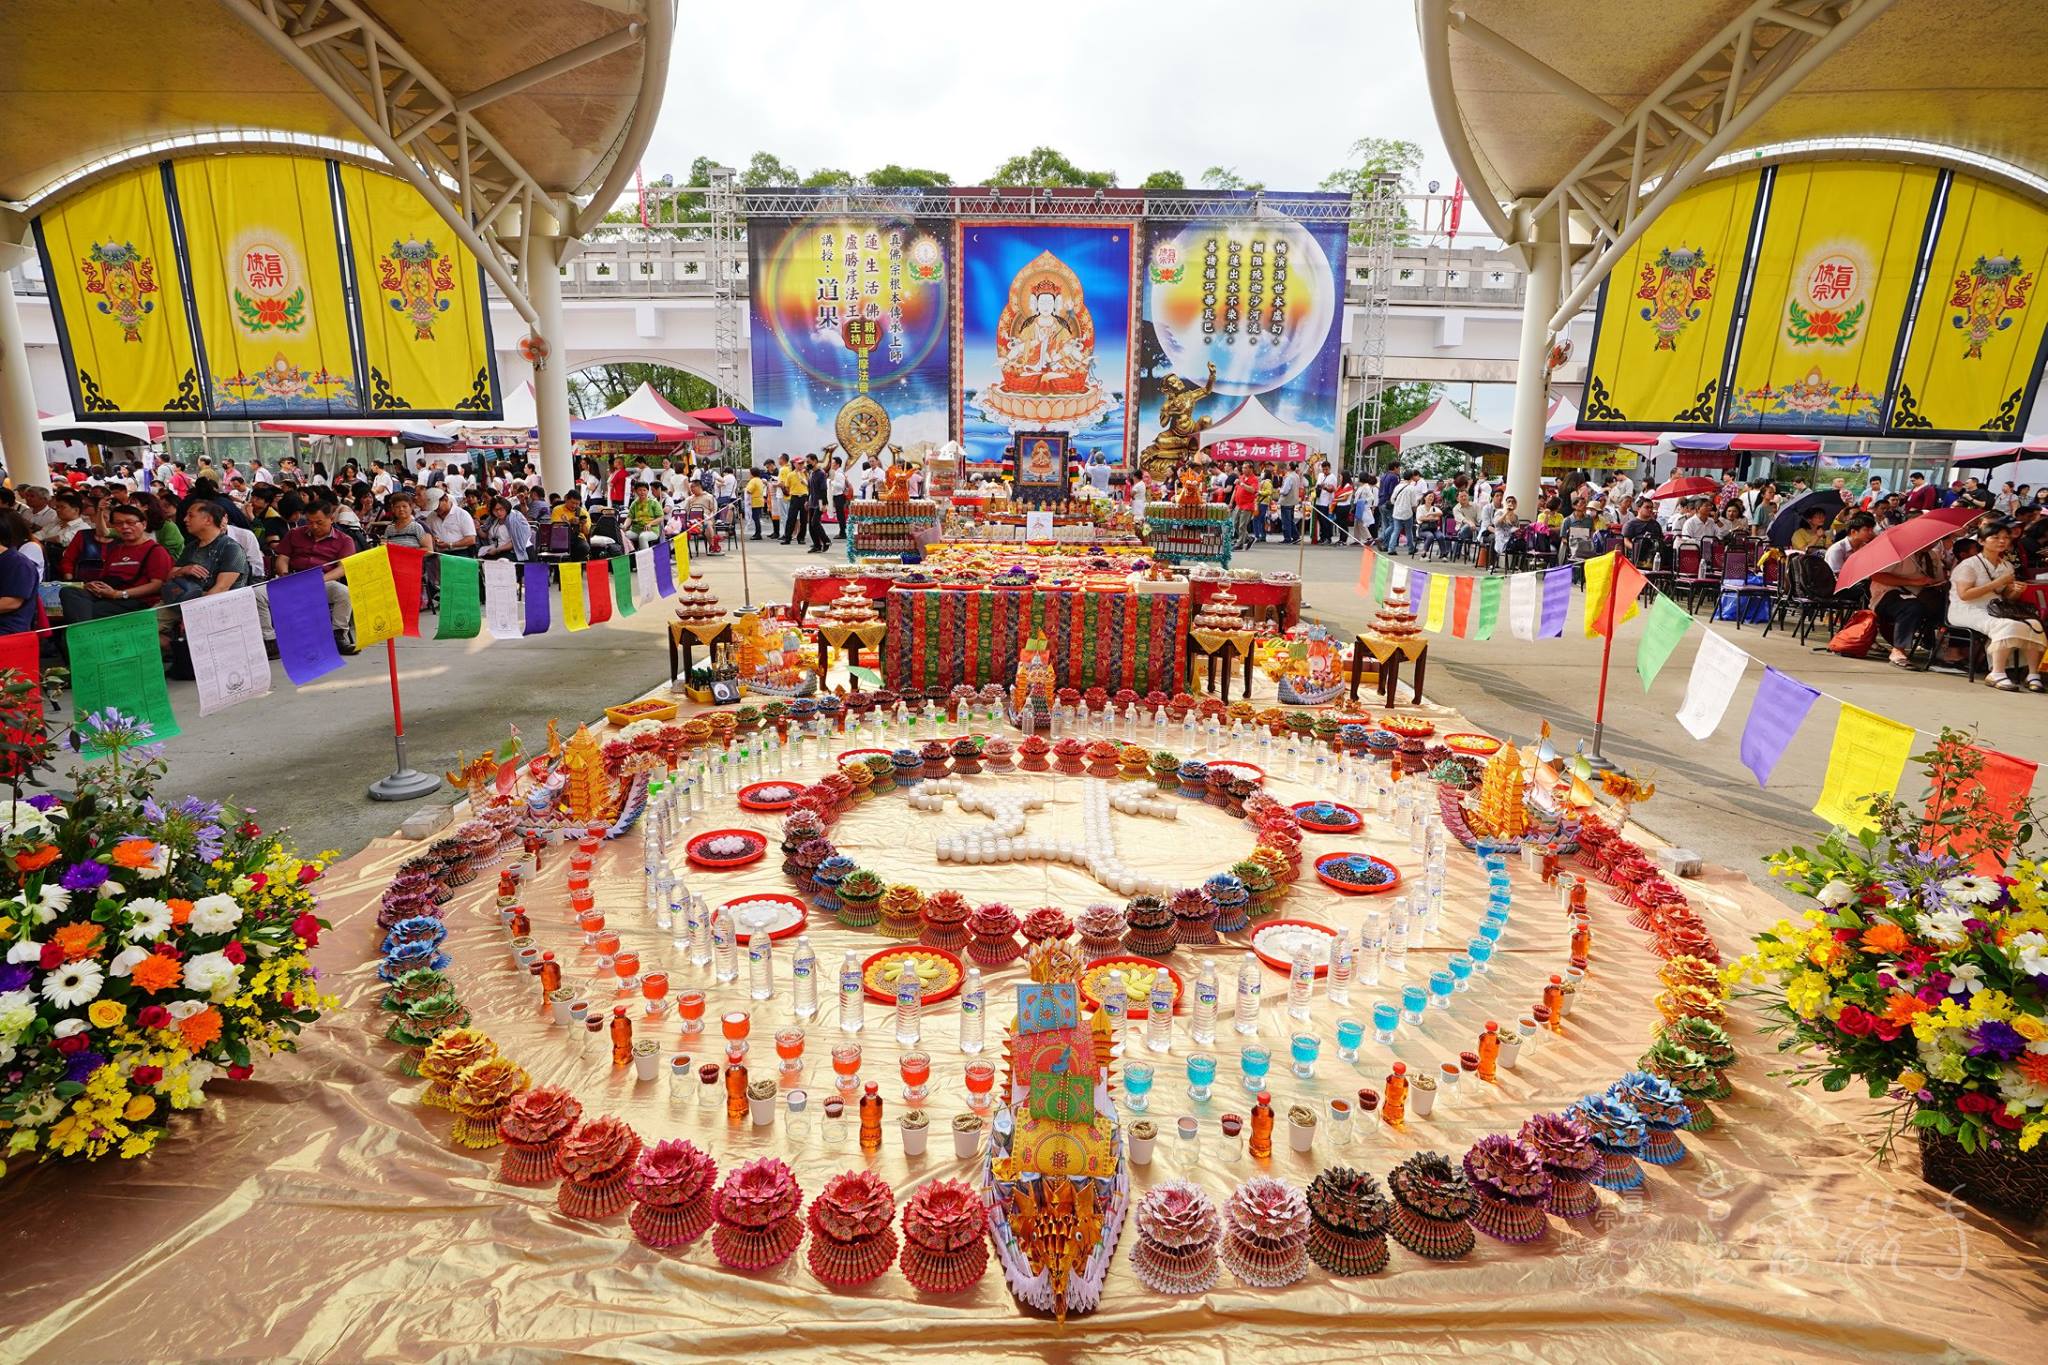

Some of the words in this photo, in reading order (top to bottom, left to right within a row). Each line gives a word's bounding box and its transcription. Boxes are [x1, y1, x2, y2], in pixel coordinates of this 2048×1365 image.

[864, 233, 880, 318] 蓮生活佛
[850, 321, 862, 345] 主持
[1215, 441, 1300, 458] 供品加持區
